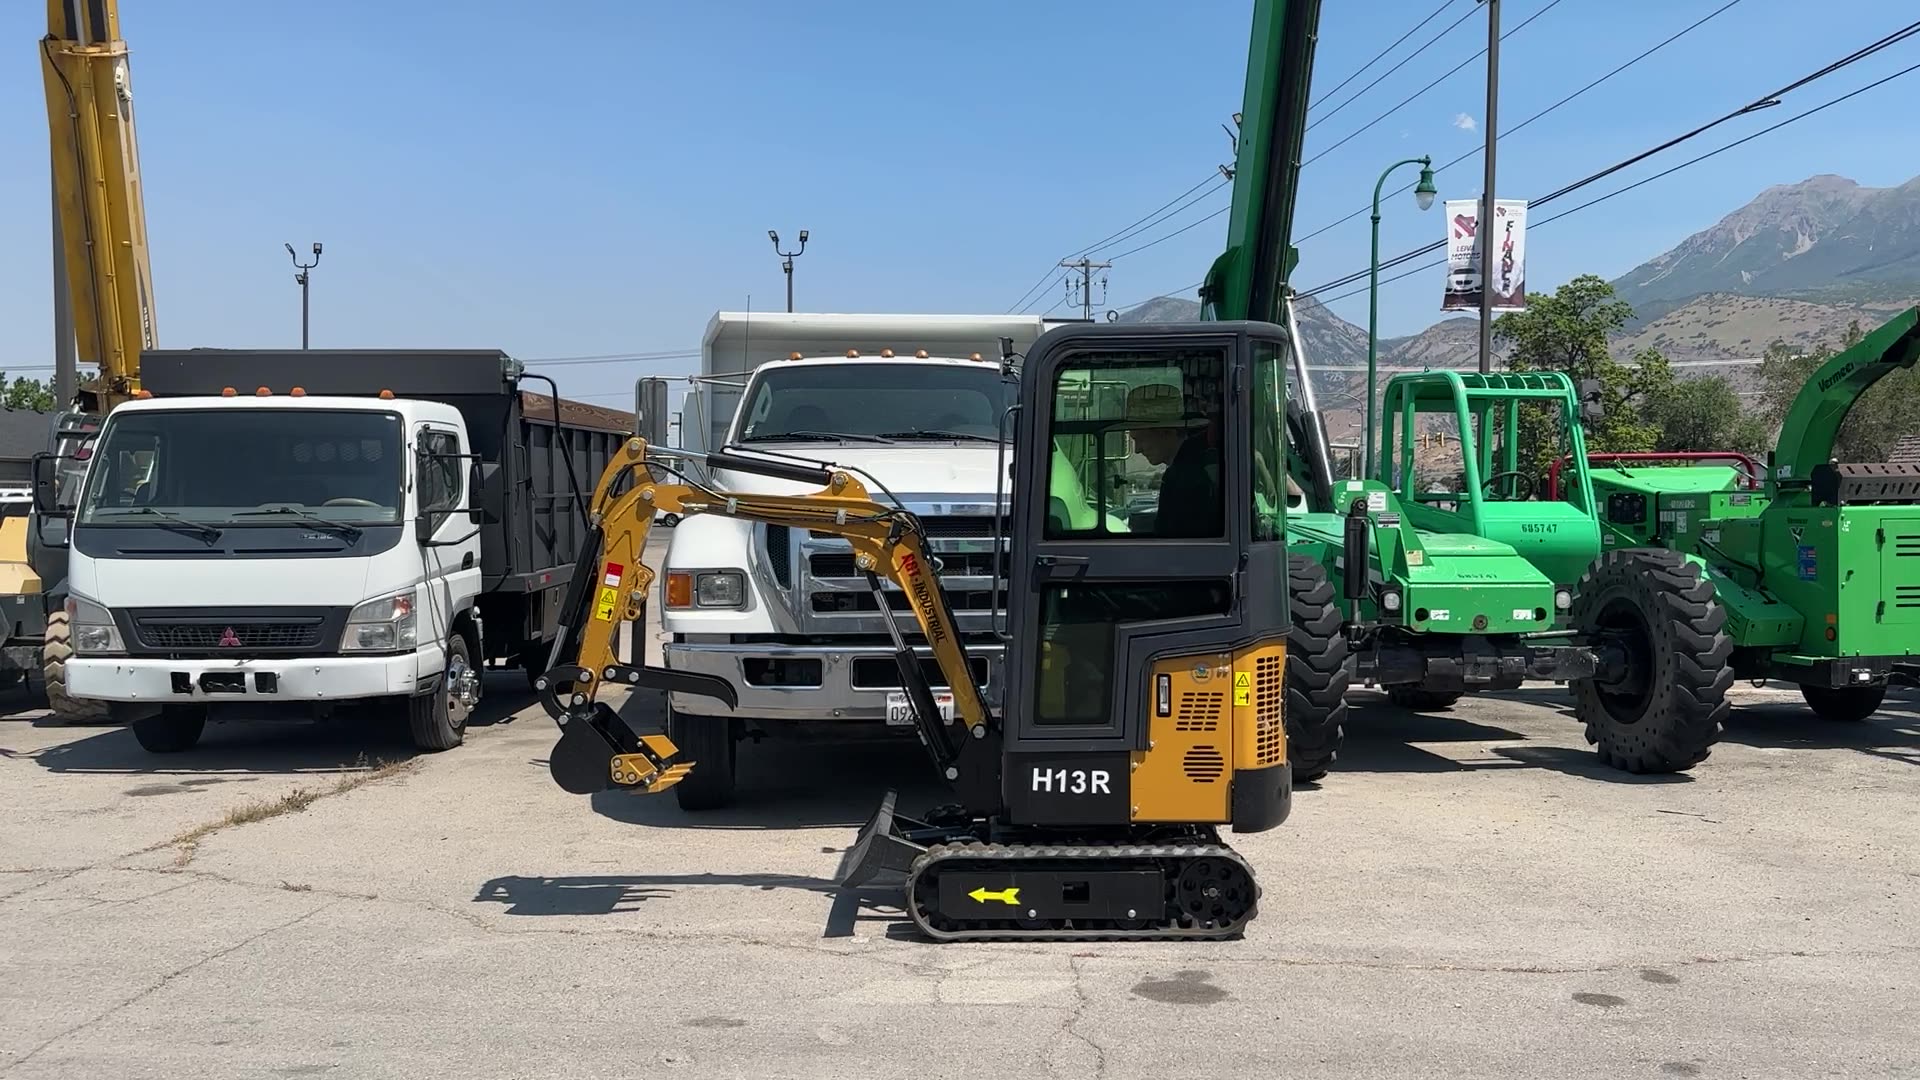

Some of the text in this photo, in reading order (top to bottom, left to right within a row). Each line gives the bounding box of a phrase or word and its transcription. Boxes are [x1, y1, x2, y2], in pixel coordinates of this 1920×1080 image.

[1450, 252, 1481, 260] MOTORS
[913, 580, 947, 643] INDUSTRIAL
[1032, 767, 1111, 794] H13R
